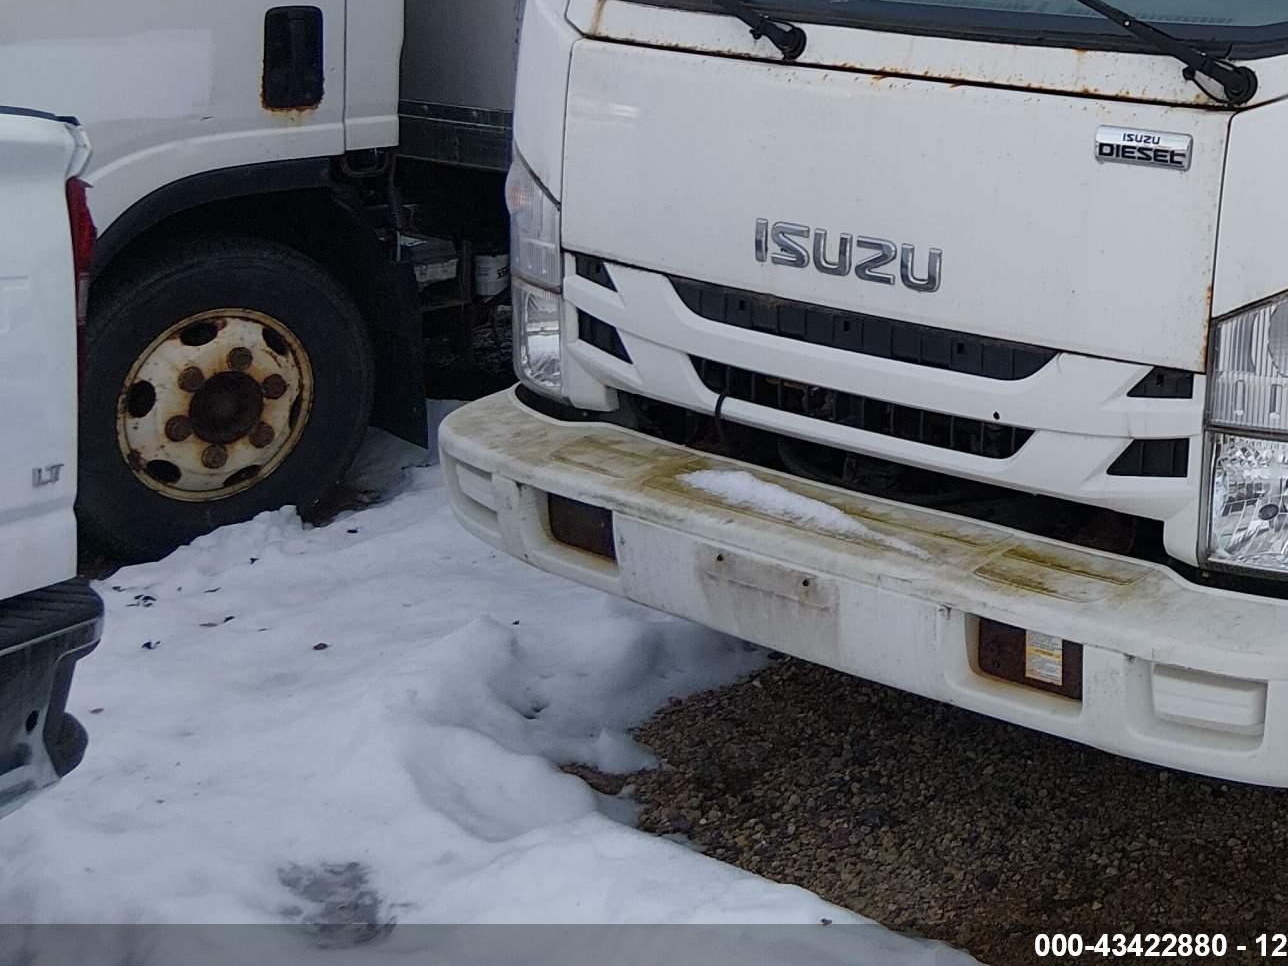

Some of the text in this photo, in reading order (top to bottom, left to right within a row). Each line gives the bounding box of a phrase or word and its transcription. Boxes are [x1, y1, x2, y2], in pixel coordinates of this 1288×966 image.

[1122, 132, 1161, 145] ISUZU
[1098, 142, 1187, 165] DIESEL
[755, 218, 943, 293] ISUZU
